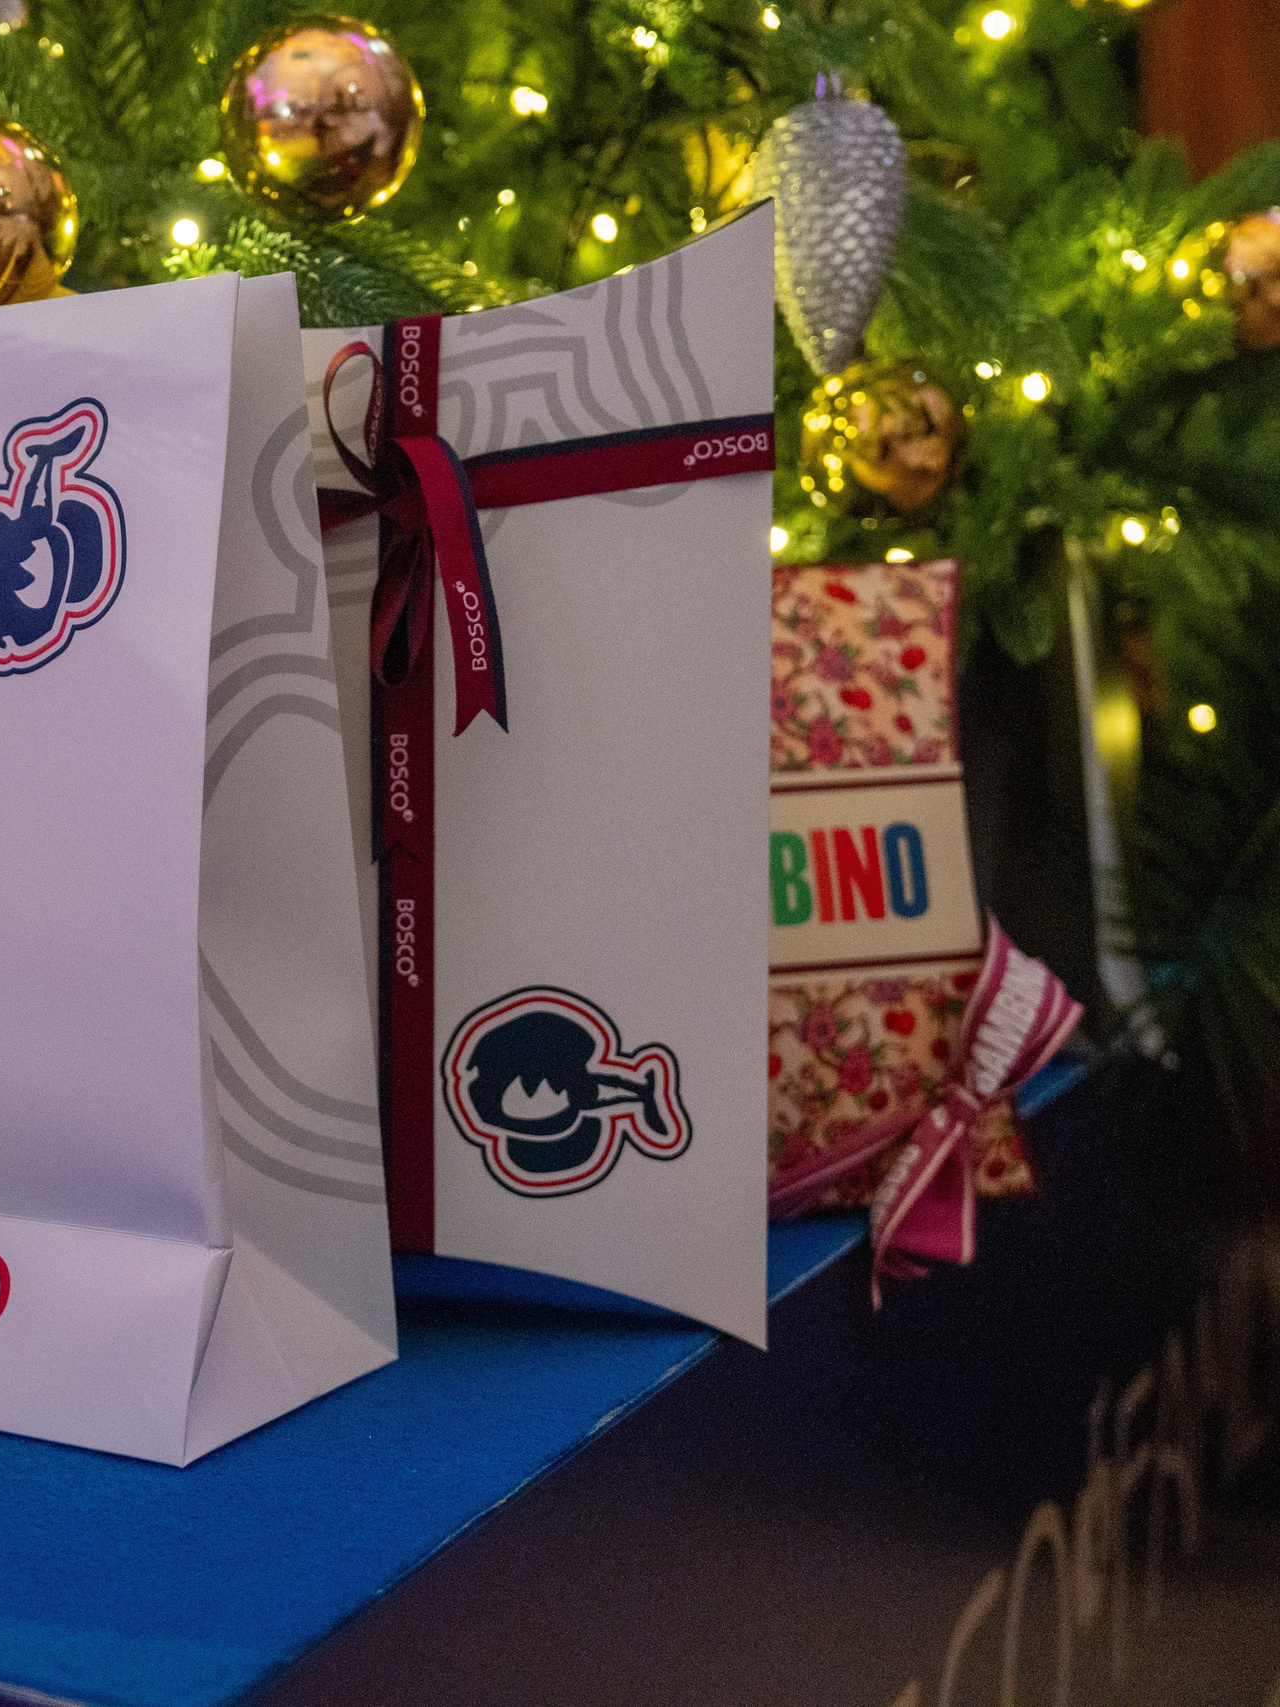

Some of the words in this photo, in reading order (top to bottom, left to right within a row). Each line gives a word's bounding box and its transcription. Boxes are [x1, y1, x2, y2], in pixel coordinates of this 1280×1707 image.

[400, 325, 421, 406] BOSCO
[693, 432, 769, 460] BOSCO
[462, 591, 487, 671] BOSCO
[389, 733, 410, 812] BOSCO
[770, 821, 930, 927] BINO
[396, 899, 416, 976] BOSCO
